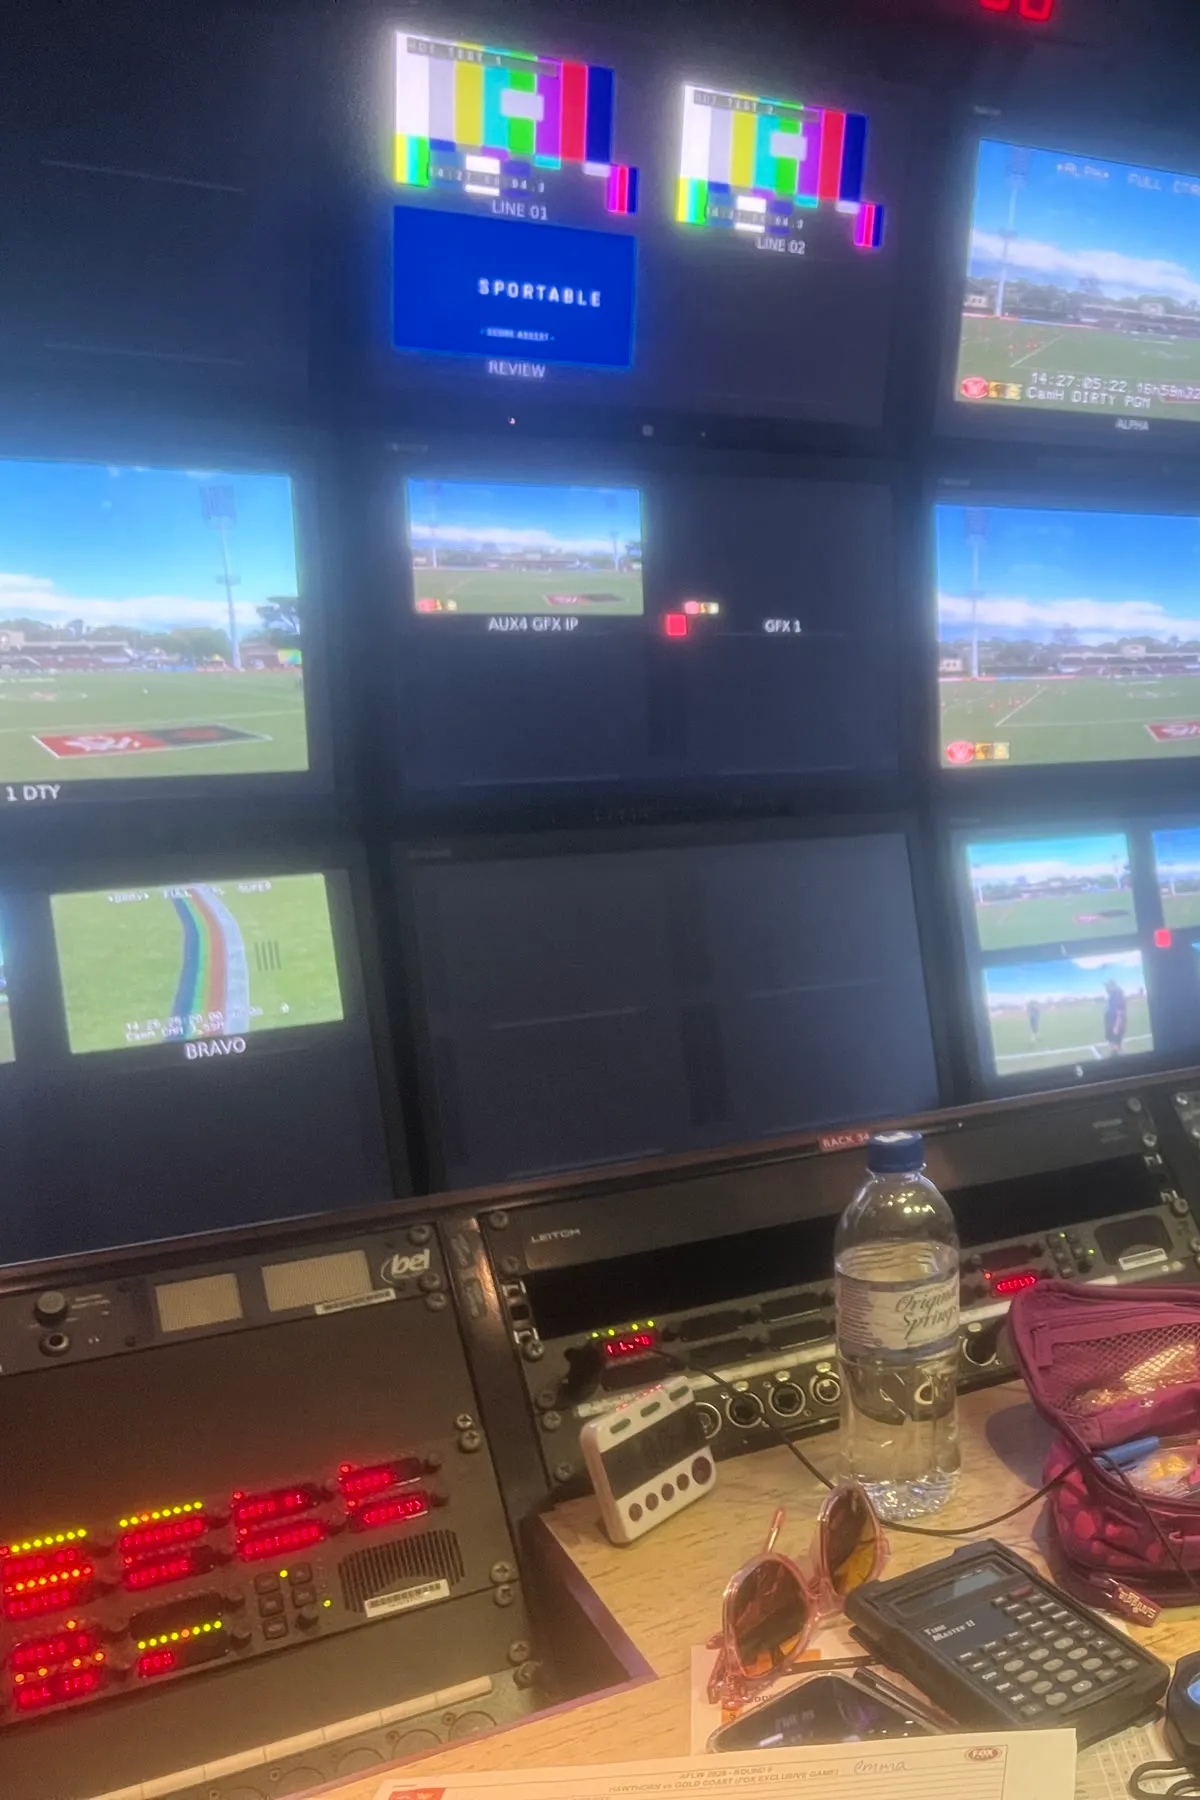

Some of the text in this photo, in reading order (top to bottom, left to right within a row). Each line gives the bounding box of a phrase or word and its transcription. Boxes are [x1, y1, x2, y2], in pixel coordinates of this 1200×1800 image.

[492, 199, 548, 221] LINE 01
[757, 236, 806, 255] LINE 02
[477, 277, 602, 308] SPORTABLE
[488, 359, 546, 379] REVIEW
[1031, 371, 1128, 394] 14:27:05:22
[1026, 387, 1152, 409] CamH DIRTY PGM
[1115, 417, 1150, 432] ALPHA
[488, 616, 578, 633] AUX4 GFX IP
[764, 618, 790, 634] GFX
[6, 783, 61, 802] 1 DTY
[183, 1035, 248, 1060] BRAVO
[822, 1135, 855, 1149] RACK
[530, 1227, 581, 1244] LEITCH
[390, 1248, 431, 1276] bel
[734, 1767, 765, 1777] ROUND
[609, 1783, 660, 1793] HAWTHORN
[674, 1779, 701, 1789] GOLD
[703, 1776, 733, 1787] COAST
